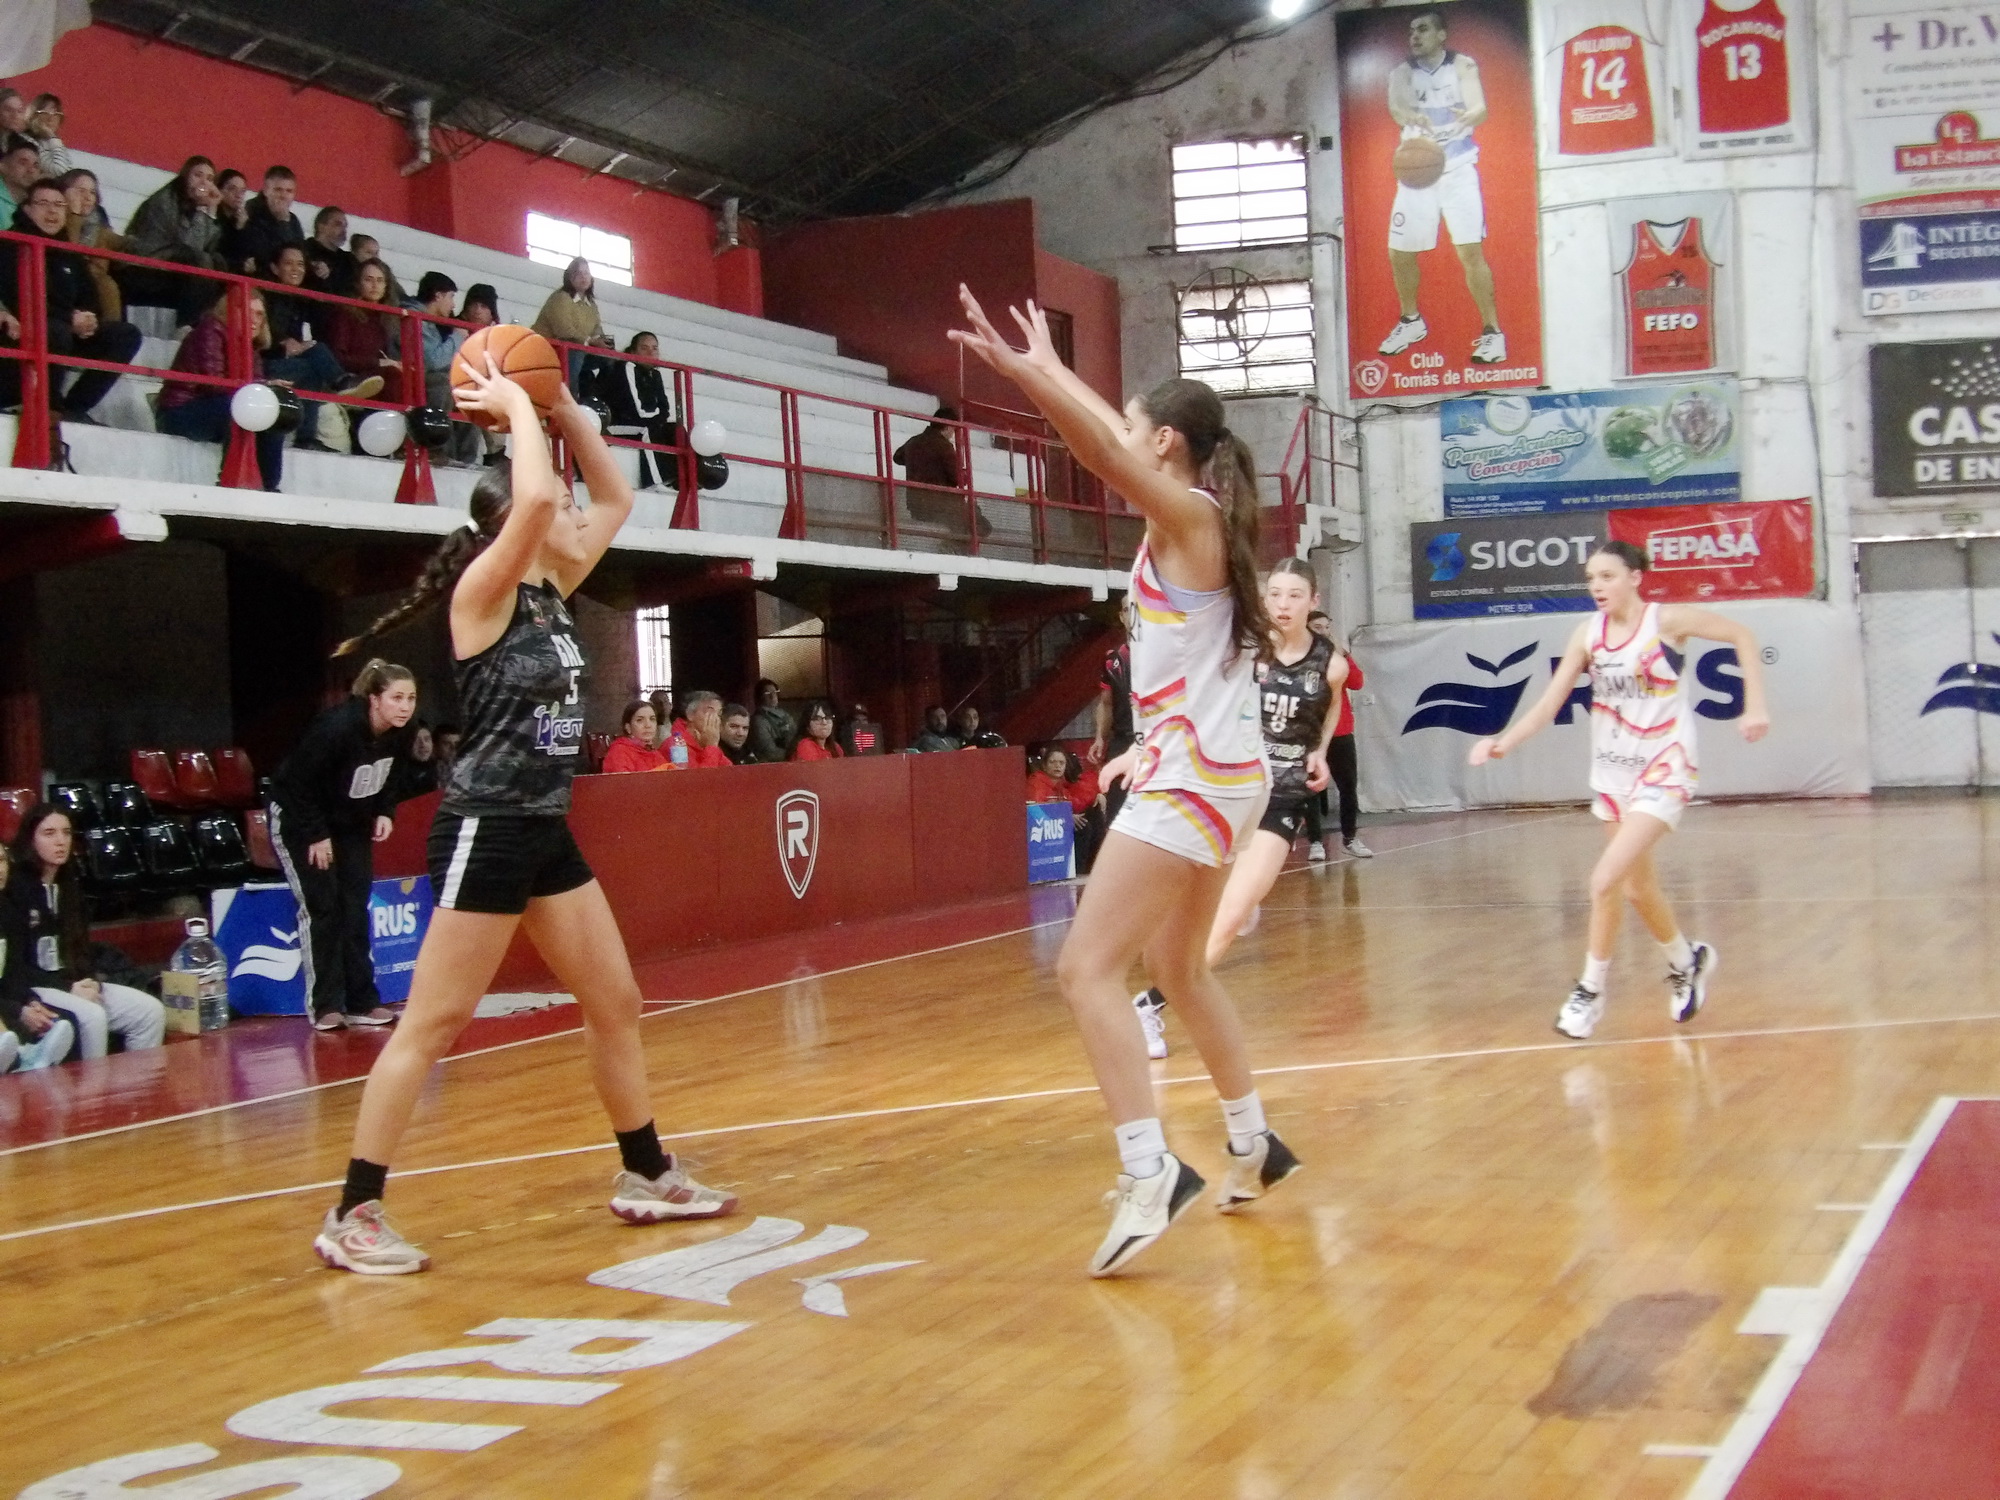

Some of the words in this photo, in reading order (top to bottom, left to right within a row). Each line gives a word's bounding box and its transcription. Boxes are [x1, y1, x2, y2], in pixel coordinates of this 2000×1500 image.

[1723, 43, 1762, 81] 13
[1581, 56, 1628, 99] 14
[1644, 313, 1699, 332] FEFO
[1410, 351, 1444, 369] Club
[1392, 371, 1440, 389] Tomás
[1443, 369, 1460, 385] de
[1464, 366, 1538, 385] Rocamora
[1908, 403, 2000, 447] CAS
[1445, 445, 1508, 468] Parque
[1470, 451, 1564, 480] Concepción
[1914, 459, 1954, 482] DE
[1961, 457, 2000, 480] EN
[1470, 535, 1597, 571] SIGOT
[1647, 532, 1761, 562] FEPASA
[564, 669, 581, 705] 5
[1550, 647, 1747, 726] RS
[787, 810, 810, 859] R
[1044, 818, 1064, 841] RUS
